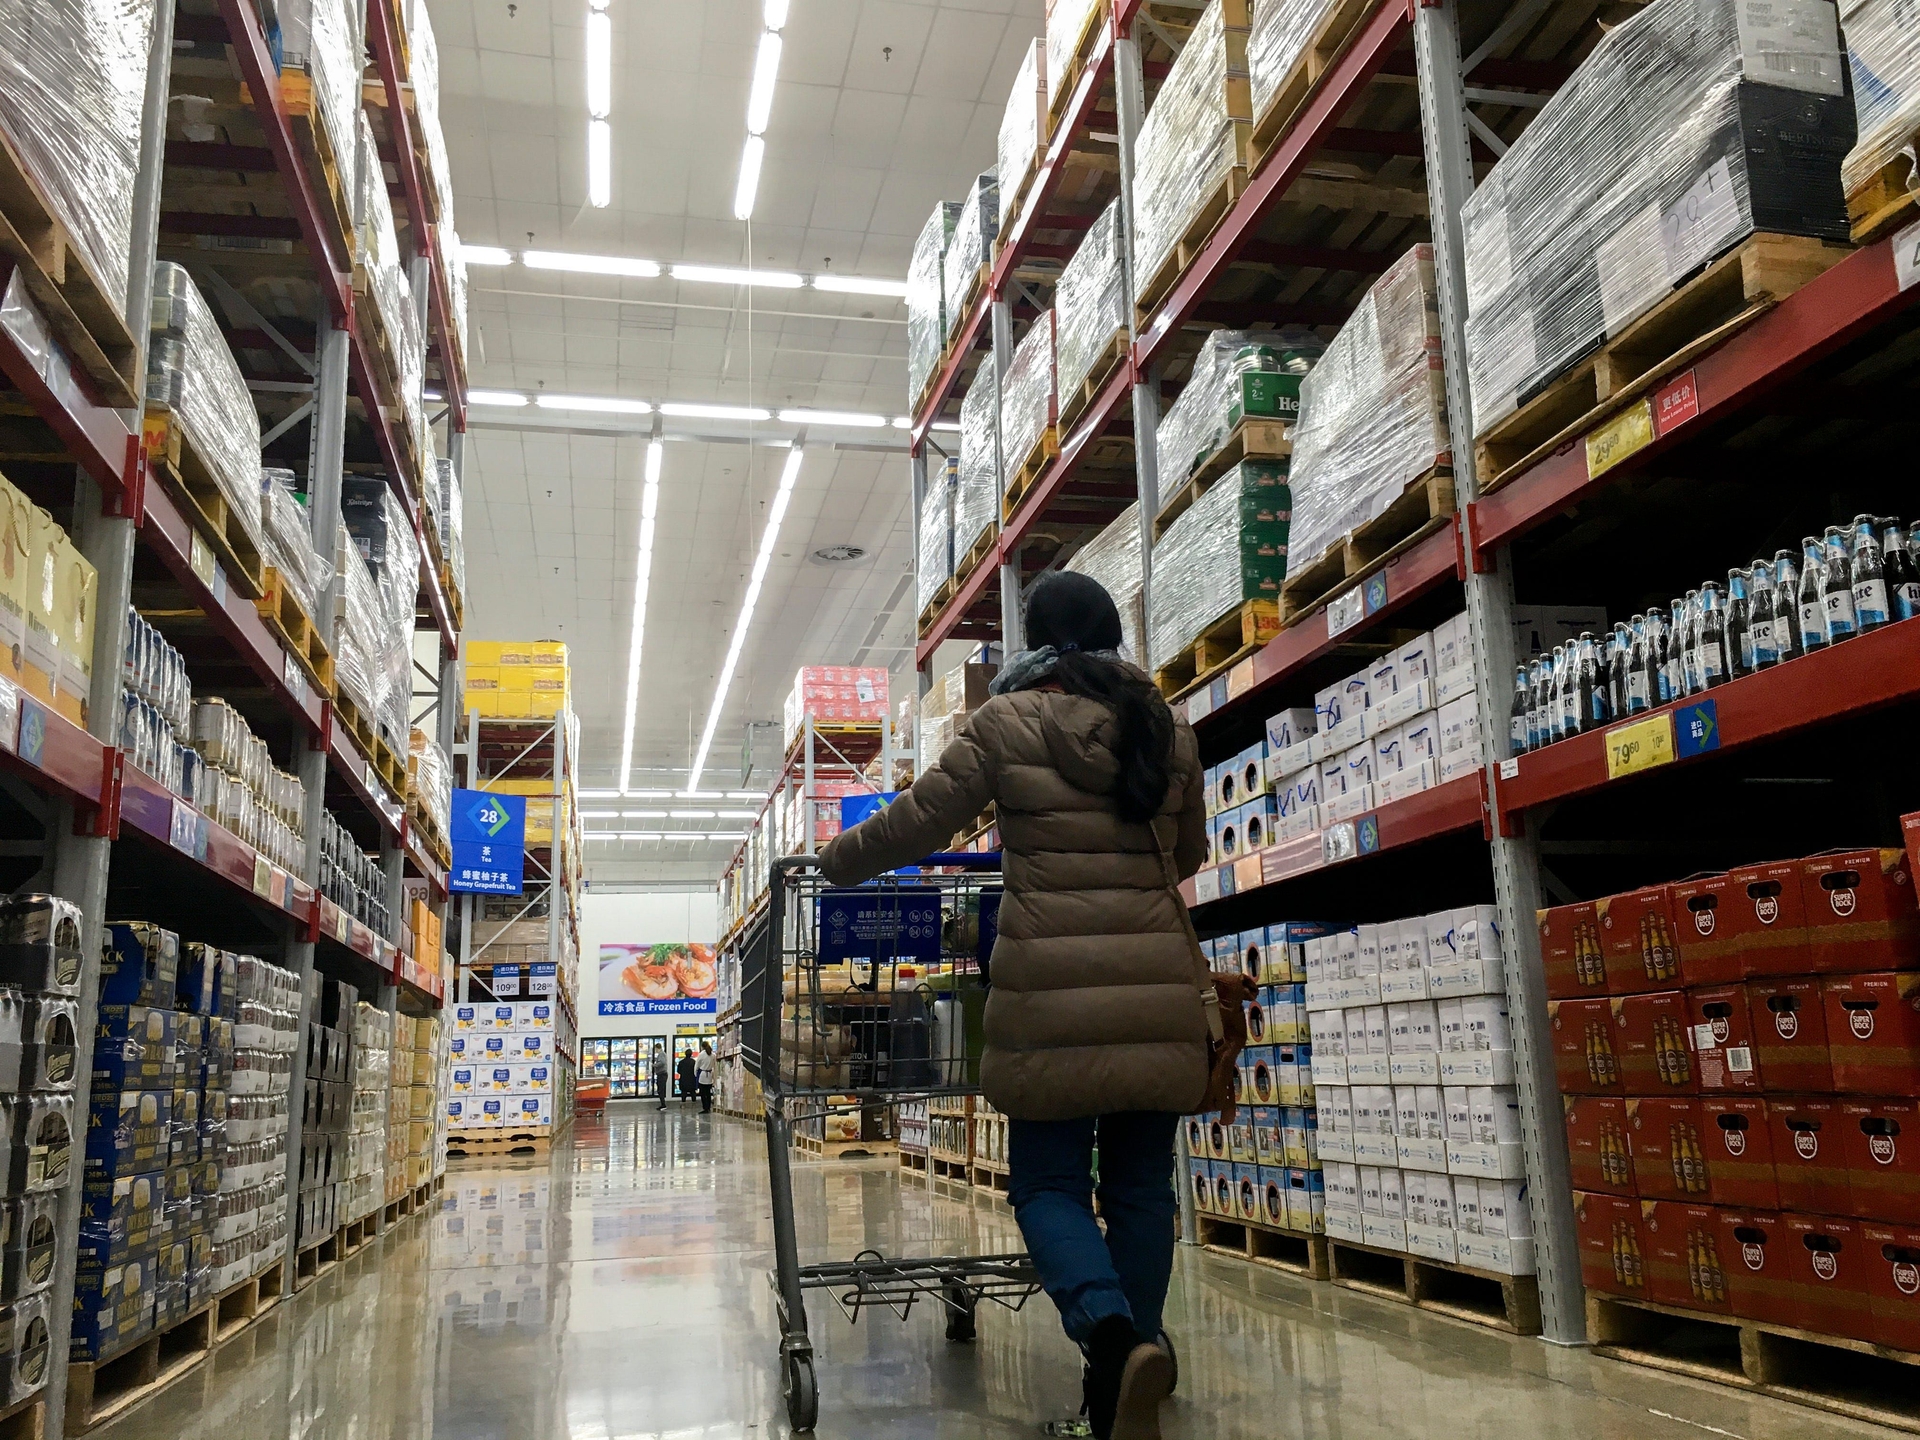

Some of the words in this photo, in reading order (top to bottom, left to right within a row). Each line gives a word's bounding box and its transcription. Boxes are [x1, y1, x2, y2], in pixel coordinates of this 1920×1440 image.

[1662, 385, 1690, 413] 更低价
[1853, 585, 1873, 600] ite
[1753, 625, 1770, 638] ite
[1690, 720, 1702, 729] 进口
[1692, 728, 1703, 739] 商品
[480, 809, 498, 824] 28
[482, 846, 491, 856] 茶
[1844, 857, 1871, 865] PREMIUM
[462, 870, 508, 883] 蜂蜜柚子茶
[453, 880, 474, 889] Honey
[474, 881, 505, 890] Grapefruit
[1834, 893, 1851, 901] SUPER
[1697, 914, 1712, 922] SUPER
[100, 950, 124, 963] ACK
[603, 1002, 646, 1013] 冷冻食品
[649, 1002, 681, 1011] Frozen
[683, 1001, 707, 1010] Food
[1873, 1140, 1890, 1148] SUPER
[1815, 1256, 1833, 1265] SUPER
[1817, 1263, 1833, 1271] BOCK
[1896, 1269, 1915, 1278] SUPER
[1898, 1276, 1915, 1284] BOCK
